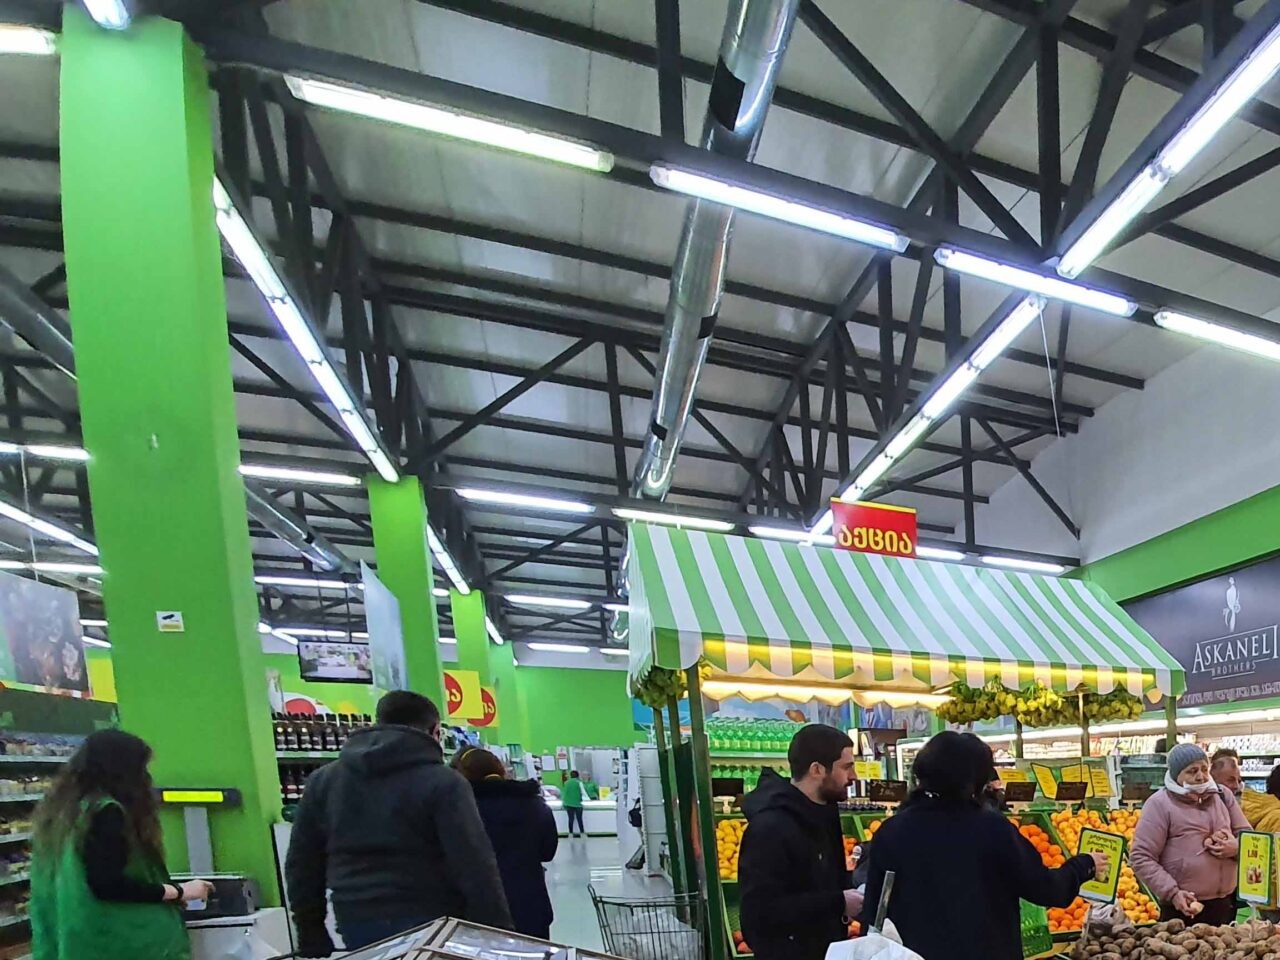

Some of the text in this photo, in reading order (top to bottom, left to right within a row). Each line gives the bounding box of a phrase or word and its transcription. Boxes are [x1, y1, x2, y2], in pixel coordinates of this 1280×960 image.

[838, 523, 913, 554] აქცია
[1192, 625, 1279, 674] ASKANELI
[1211, 661, 1257, 677] BROTHERS
